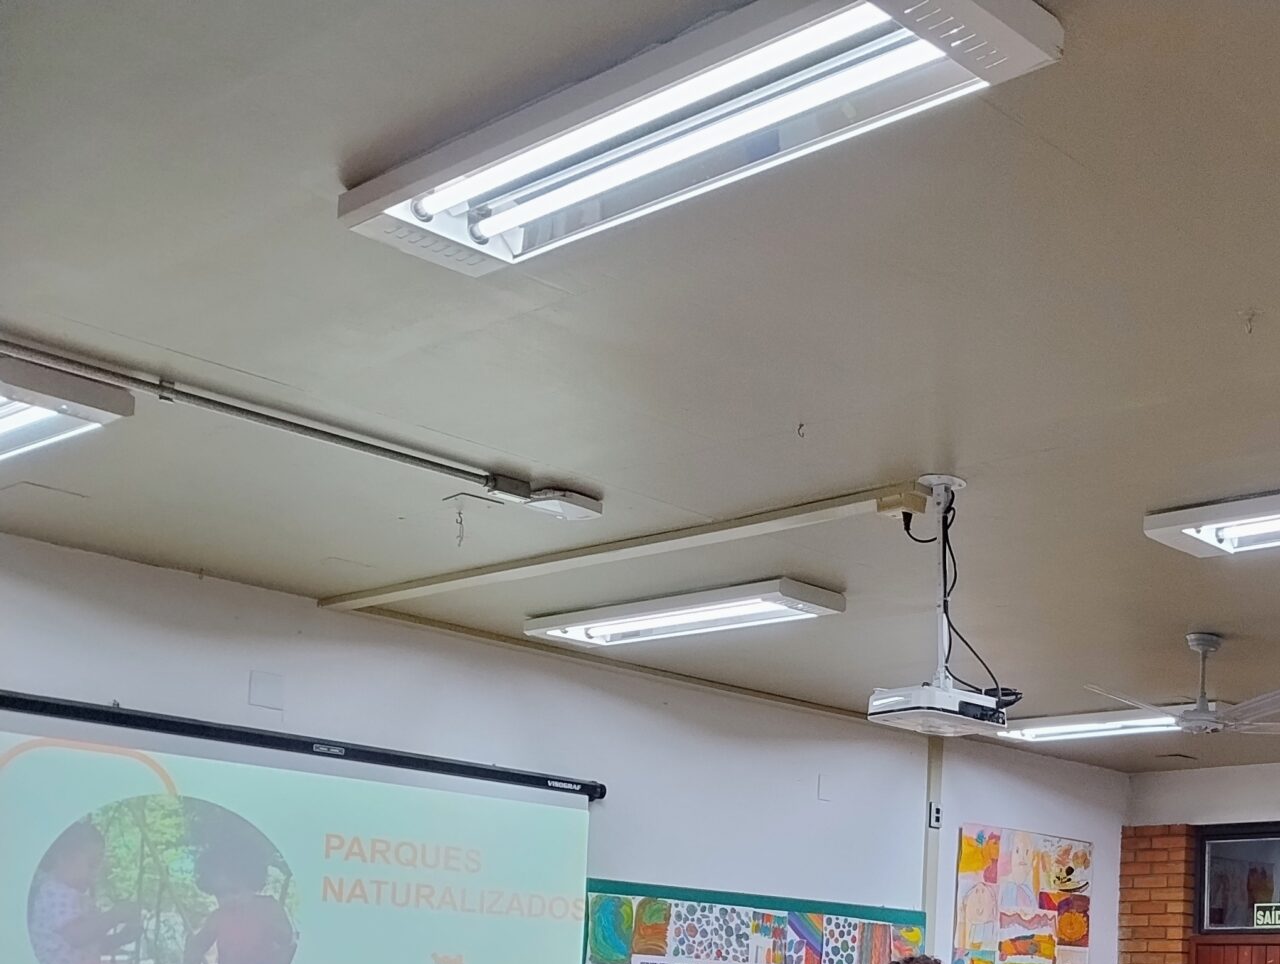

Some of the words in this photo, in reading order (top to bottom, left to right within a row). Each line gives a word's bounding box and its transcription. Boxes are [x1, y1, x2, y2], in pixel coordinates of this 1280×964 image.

[547, 780, 582, 791] VISOGRAF
[323, 832, 482, 874] PARQUES
[321, 876, 585, 922] NATURALIZADOS
